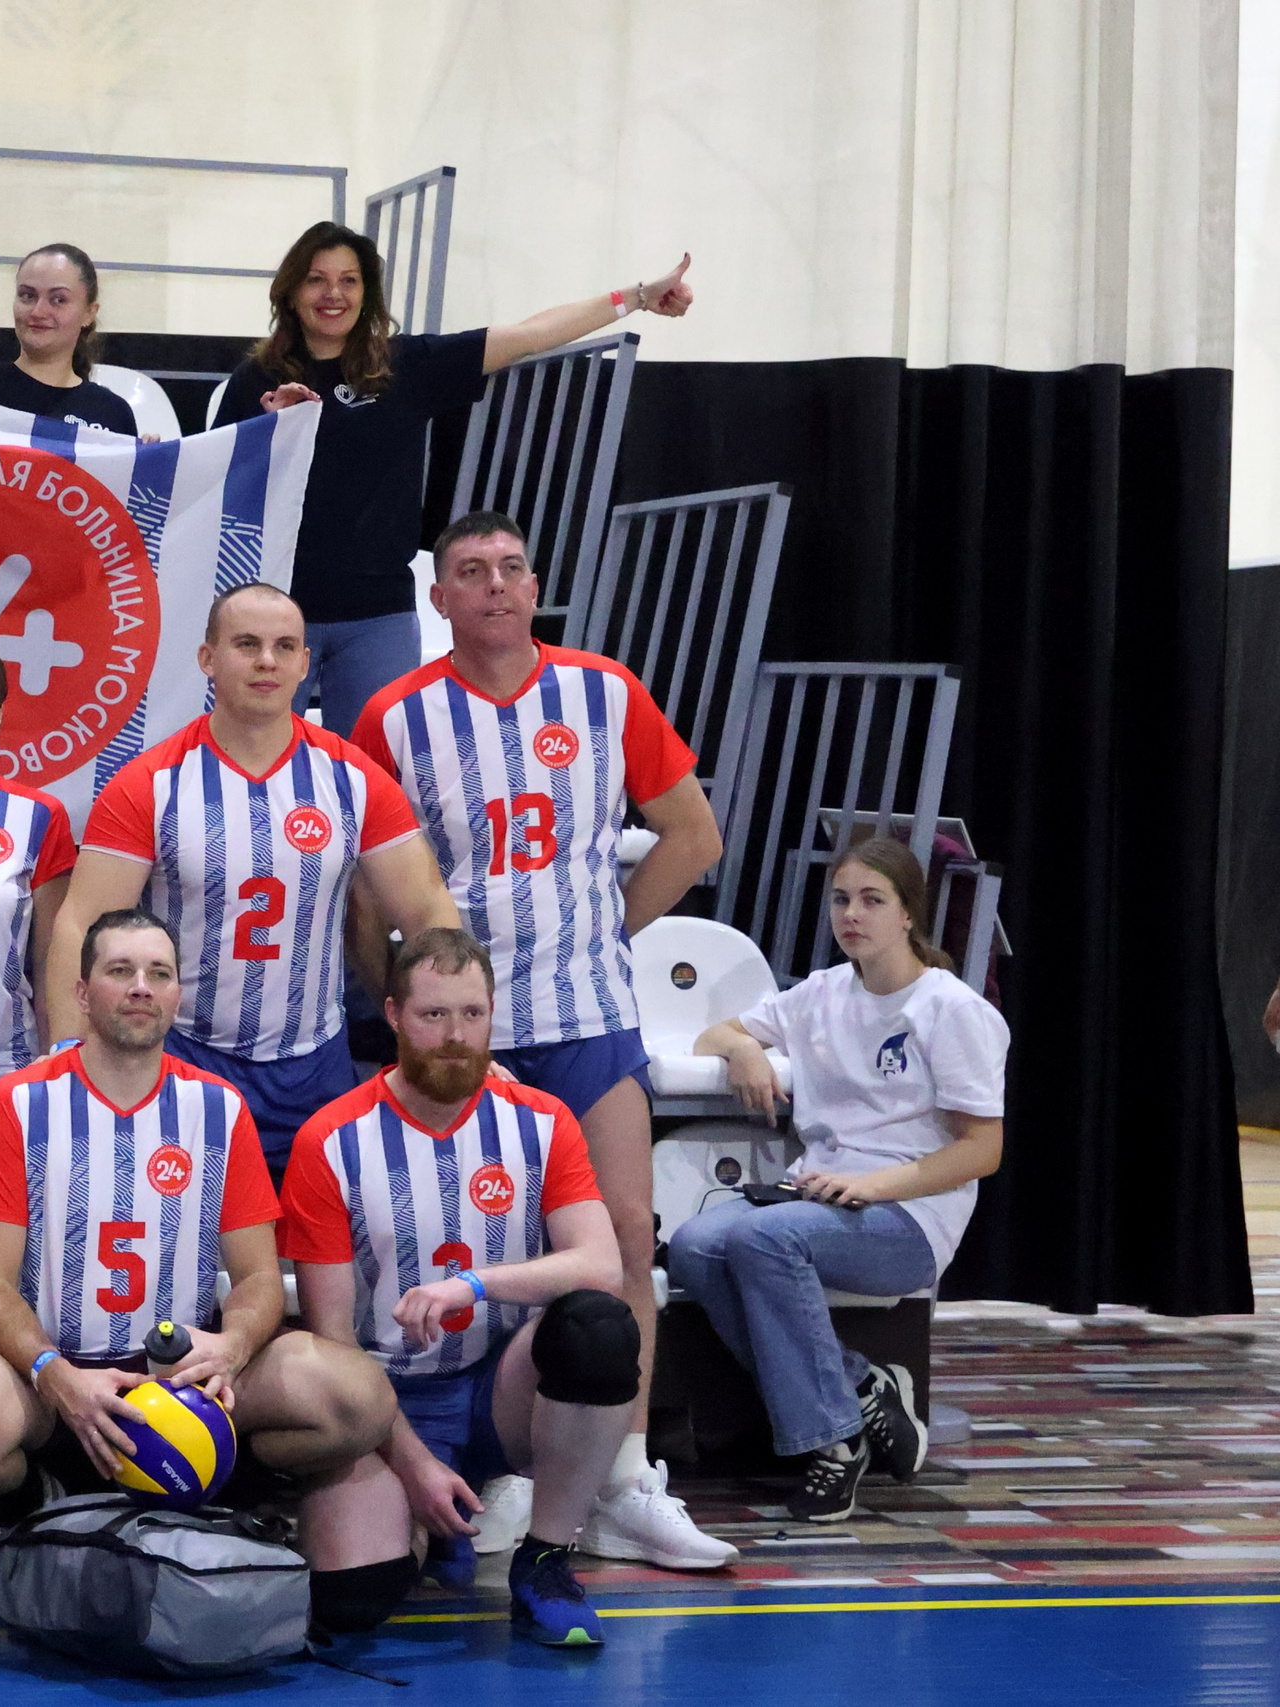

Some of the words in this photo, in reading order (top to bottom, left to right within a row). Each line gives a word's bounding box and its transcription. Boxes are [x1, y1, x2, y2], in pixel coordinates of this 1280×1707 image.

[36, 472, 145, 636] БОЛЬНИЦА
[541, 736, 571, 756] 24
[293, 819, 324, 839] 24
[486, 792, 557, 876] 13
[233, 877, 286, 960] 2
[156, 1160, 186, 1181] 24
[479, 1178, 511, 1200] 24
[96, 1222, 145, 1312] 5
